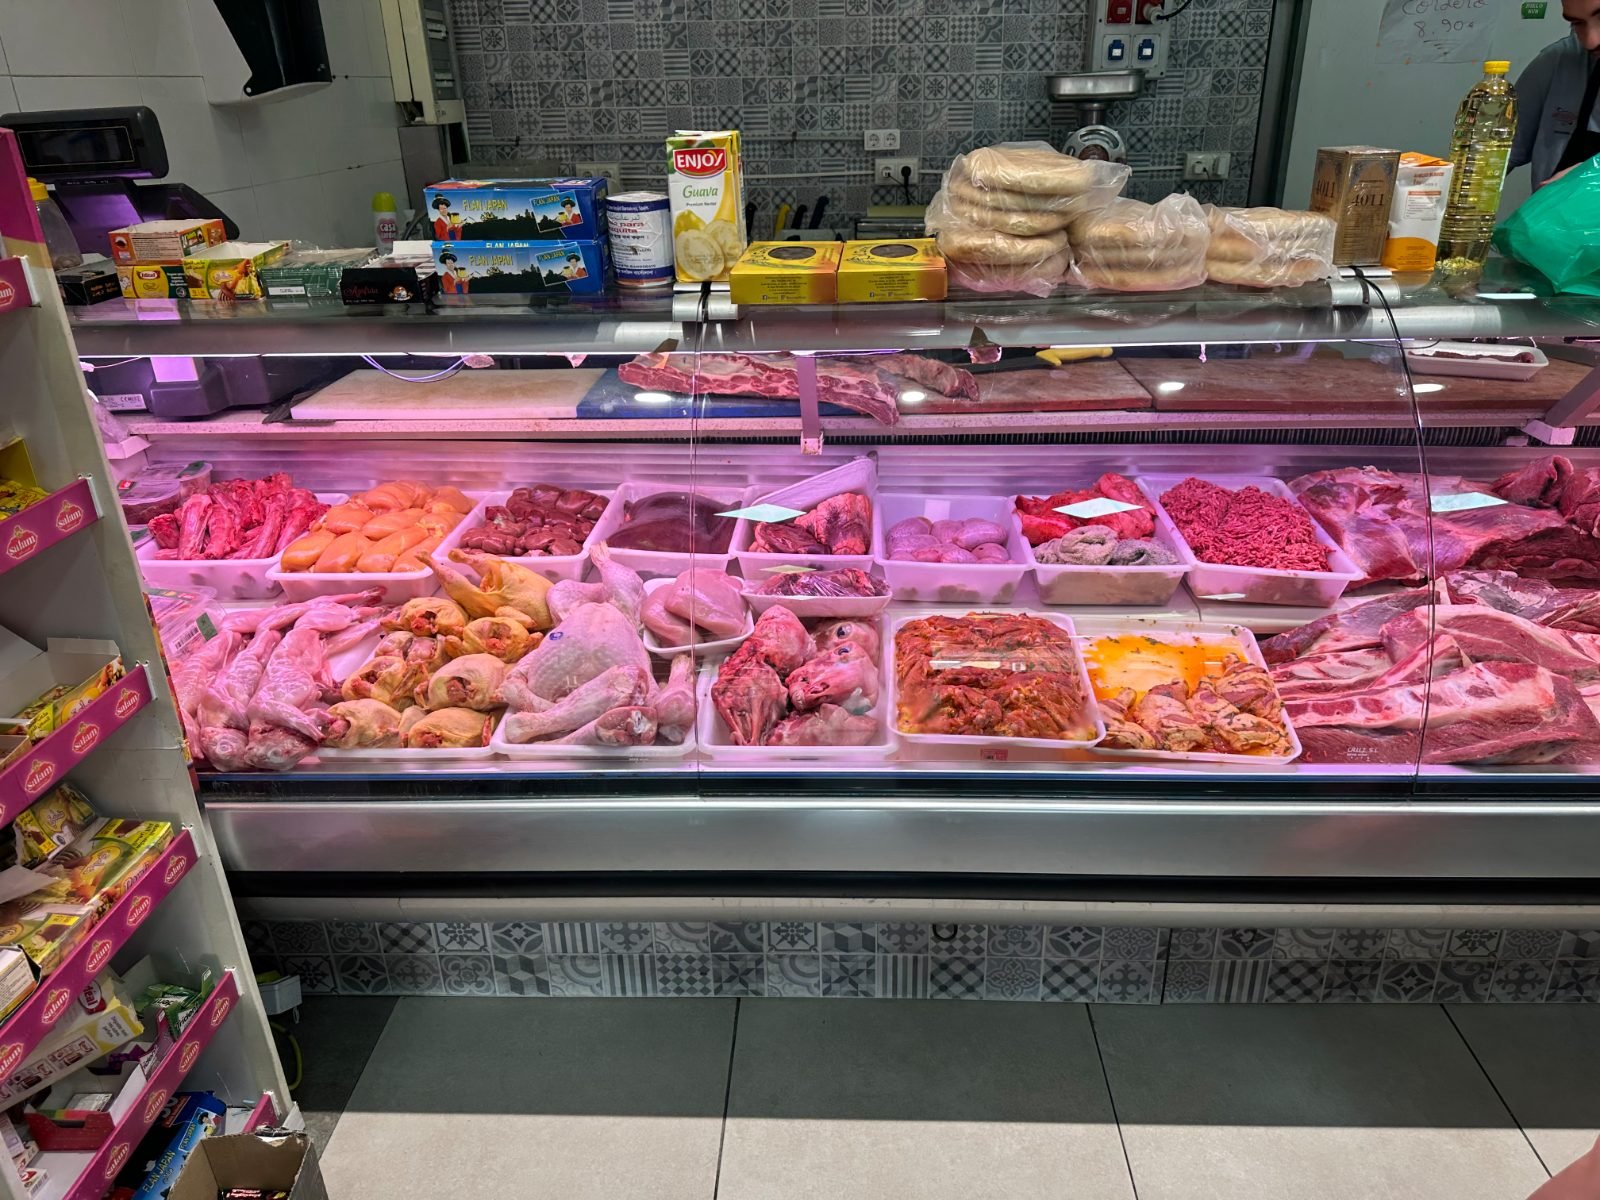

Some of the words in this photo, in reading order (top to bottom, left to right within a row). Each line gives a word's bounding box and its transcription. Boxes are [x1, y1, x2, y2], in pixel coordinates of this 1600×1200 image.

[676, 151, 724, 169] ENJOY
[683, 185, 718, 198] Guava
[462, 200, 482, 211] FLAN
[484, 200, 507, 211] JAPAN
[1351, 194, 1384, 206] 4011
[468, 255, 489, 266] FLAN
[490, 255, 513, 266] JAPAN
[143, 1168, 162, 1193] FLAN
[157, 1150, 176, 1175] JAPAN
